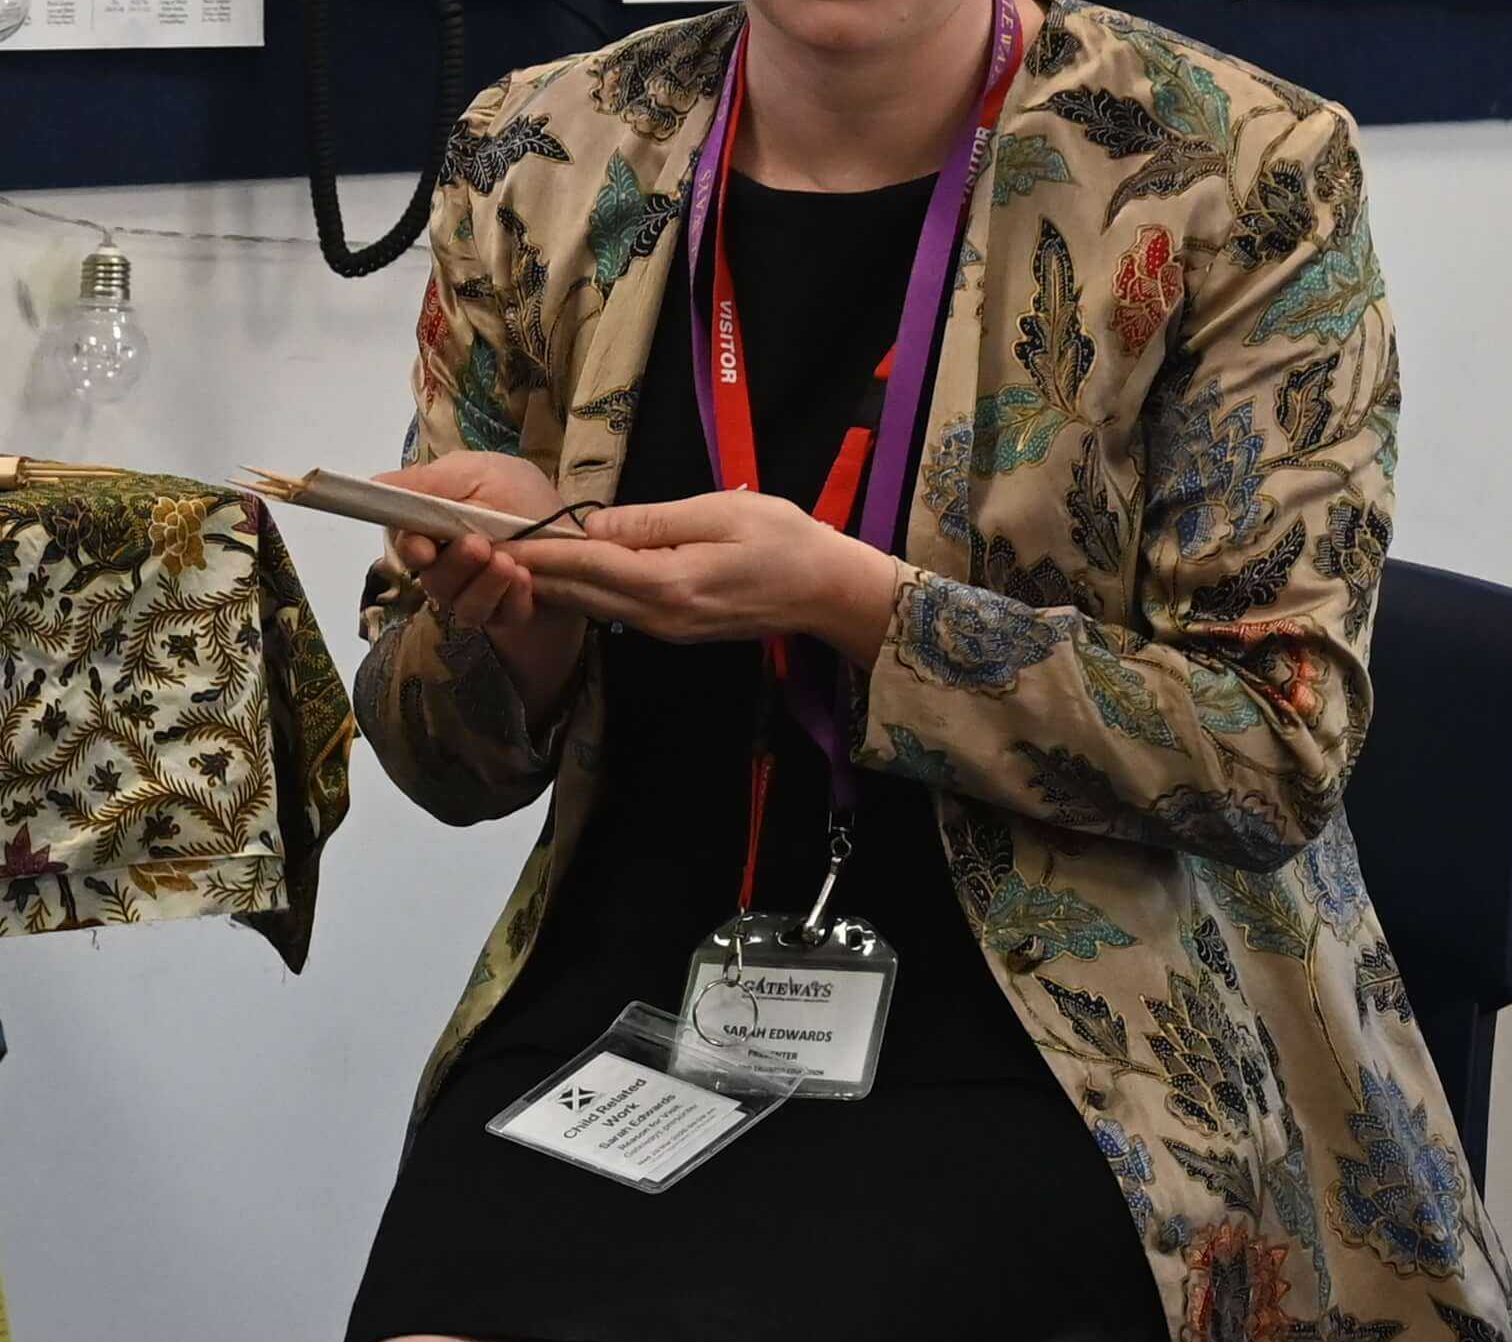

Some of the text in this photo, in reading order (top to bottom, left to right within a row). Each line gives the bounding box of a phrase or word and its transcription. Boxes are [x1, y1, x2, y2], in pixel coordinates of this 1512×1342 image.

[719, 300, 738, 384] VISITOR
[741, 974, 834, 999] GATEWAYS
[723, 1025, 833, 1043] SARAH EDWARDS
[563, 1077, 648, 1140] Child Related
[601, 1102, 640, 1128] Work
[628, 1093, 676, 1129] Edwards
